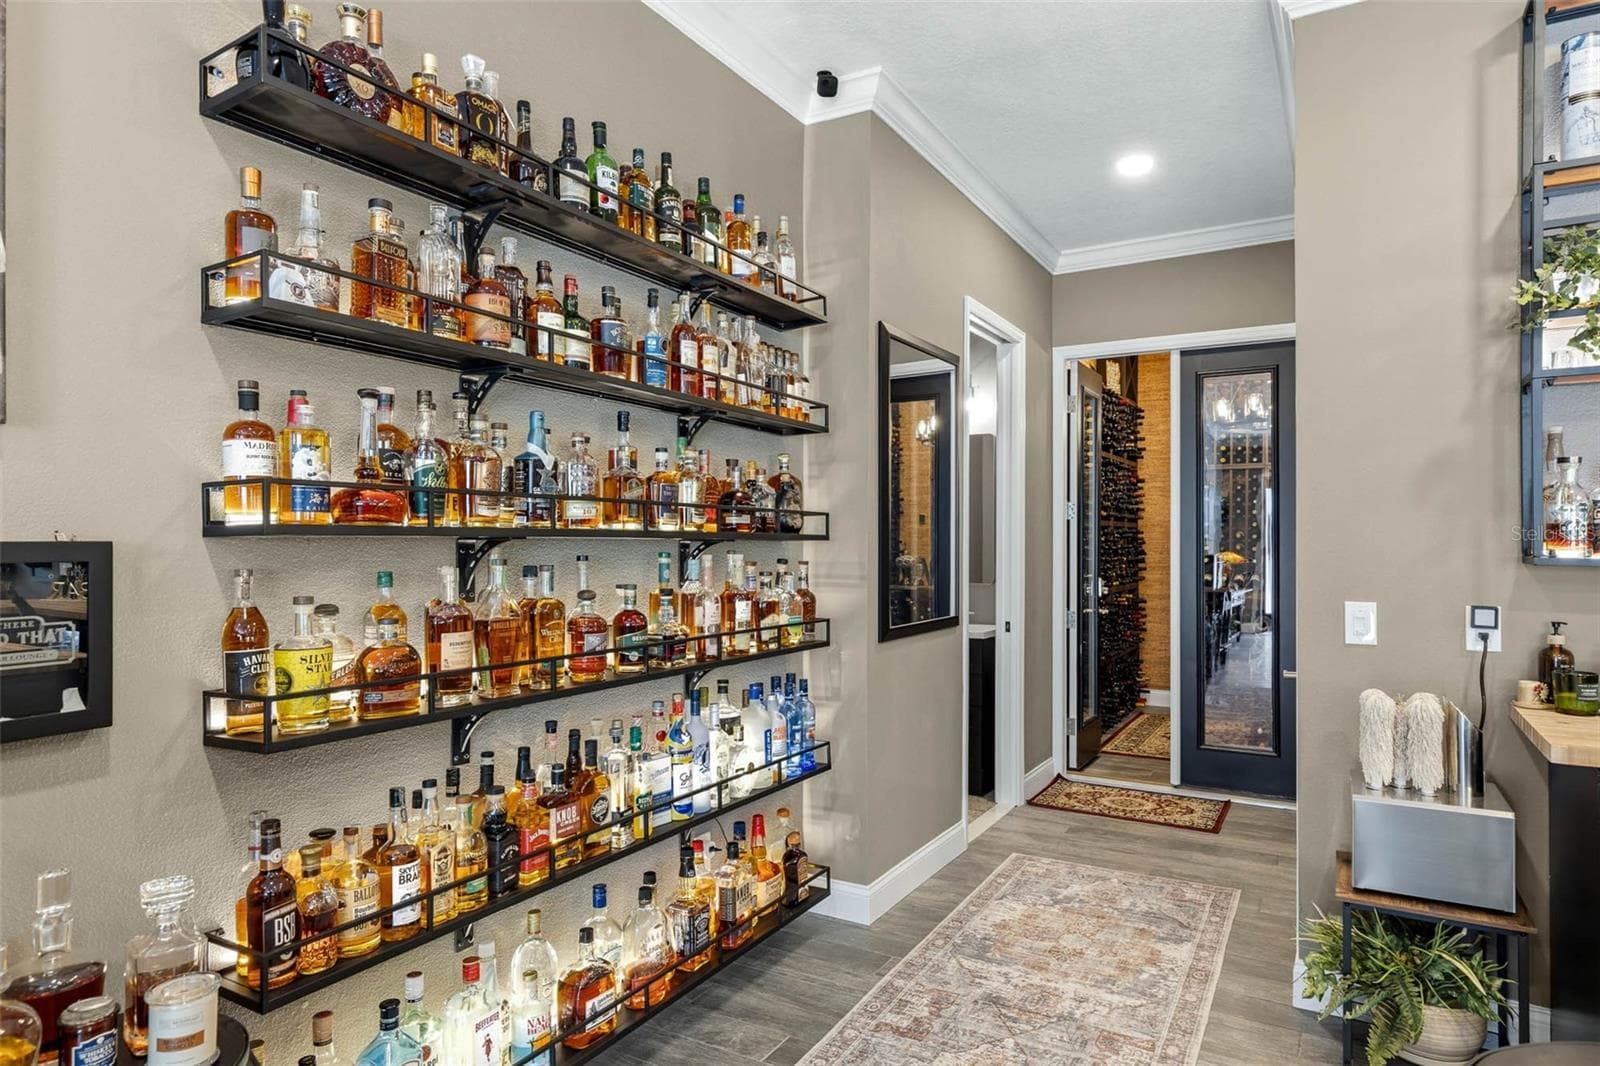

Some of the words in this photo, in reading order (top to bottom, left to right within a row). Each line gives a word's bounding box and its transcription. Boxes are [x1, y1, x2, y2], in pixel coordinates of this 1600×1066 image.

[517, 278, 525, 339] BHAKA
[0, 620, 35, 630] HERE
[16, 627, 67, 645] THAT
[556, 805, 577, 824] KNOB
[274, 911, 296, 946] BSB
